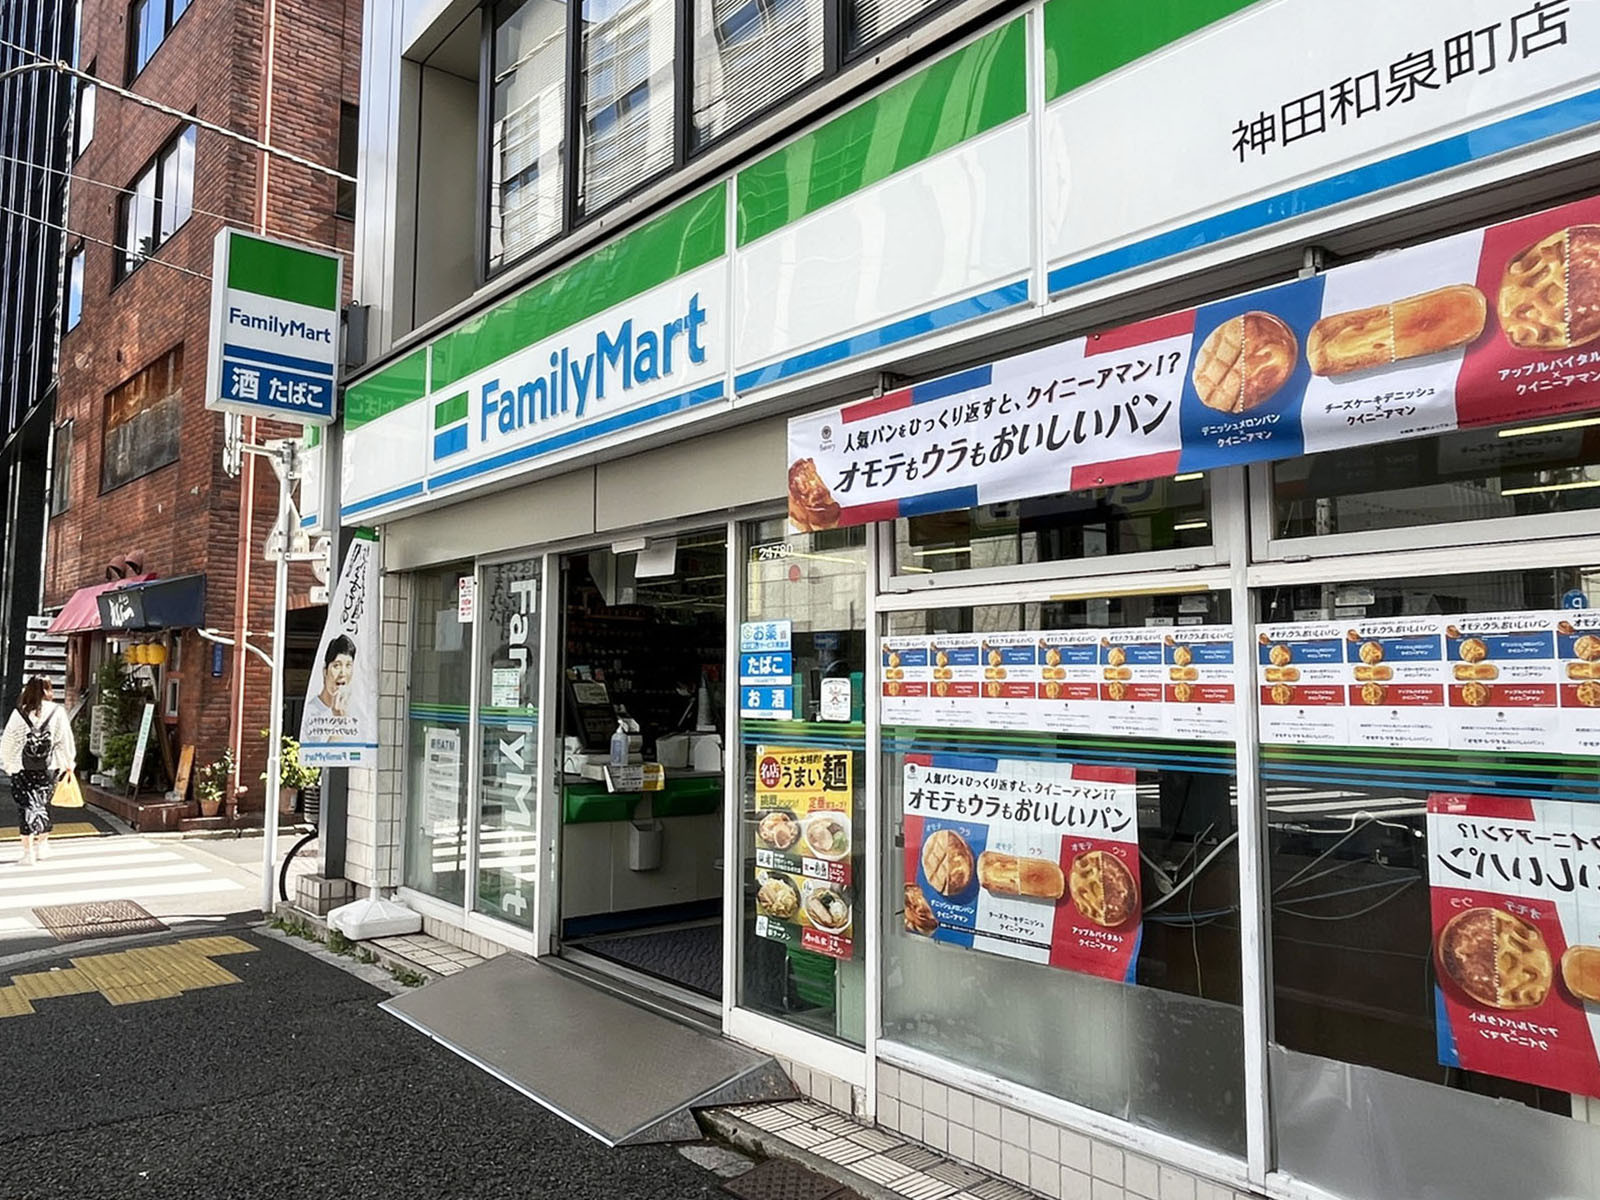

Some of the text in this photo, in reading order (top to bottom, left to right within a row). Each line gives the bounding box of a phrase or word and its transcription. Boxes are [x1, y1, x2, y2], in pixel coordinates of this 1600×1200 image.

[1231, 0, 1570, 163] 神田和泉町店
[229, 306, 331, 344] FamilyMart
[231, 366, 324, 409] 酒 たばこ
[481, 292, 706, 443] FamilyMart
[1347, 406, 1416, 426] クイニーアマン
[833, 393, 1172, 493] オモテもウラもおいしいパン
[1217, 431, 1272, 448] クイニーアマン
[747, 656, 784, 675] たばこ
[908, 788, 1132, 833] オモテもウラもおいしいパン
